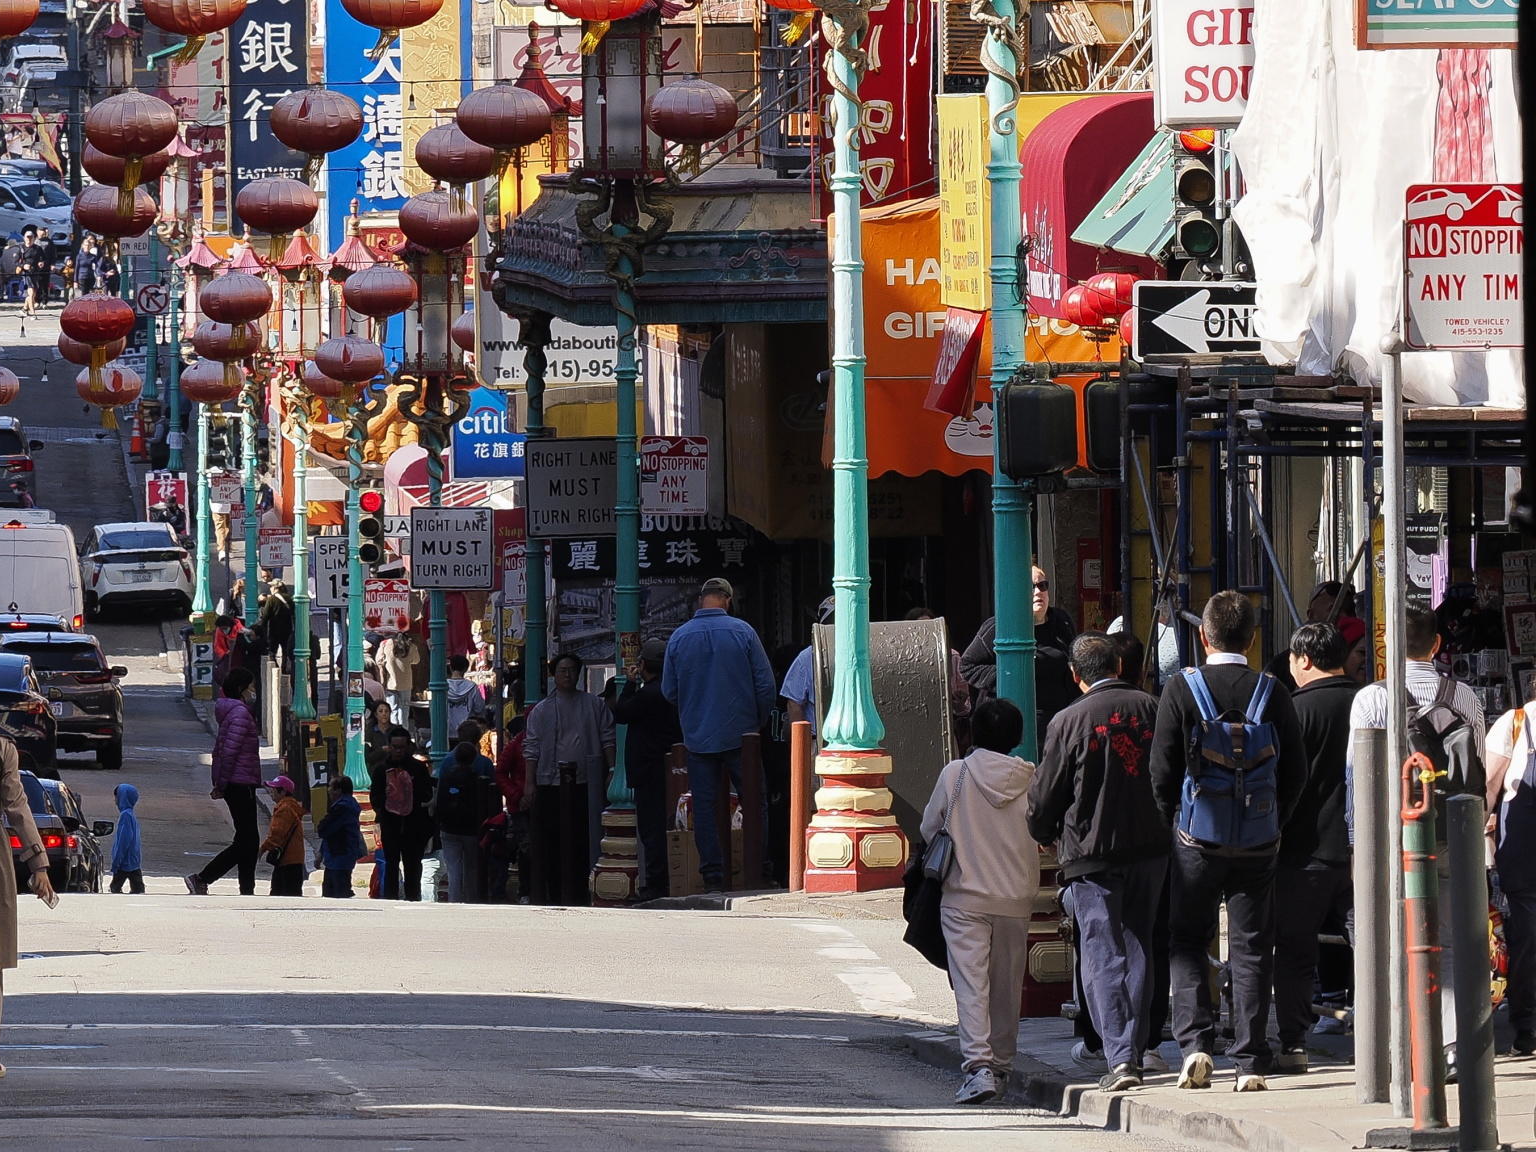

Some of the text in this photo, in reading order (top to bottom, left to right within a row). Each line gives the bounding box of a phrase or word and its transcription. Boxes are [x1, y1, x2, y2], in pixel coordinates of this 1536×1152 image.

[1410, 223, 1524, 256] NO STOPPIN
[1420, 274, 1519, 301] ANY TIM
[1445, 318, 1510, 326] TOWED VEHICLE?
[1452, 328, 1504, 336] 415-553-1235
[494, 366, 520, 379] Tel:
[531, 451, 572, 469] RIGHT
[642, 456, 706, 471] NO STOPPING
[549, 477, 601, 497] MUST
[662, 475, 687, 488] ANY
[660, 491, 689, 504] TIME
[532, 509, 564, 525] TURN
[415, 519, 488, 532] RIGHT LANE
[319, 544, 344, 555] SPE
[421, 540, 482, 556] MUST
[415, 563, 489, 577] TURN RIGHT
[365, 591, 408, 603] NO STOPPING
[368, 607, 383, 617] ANY
